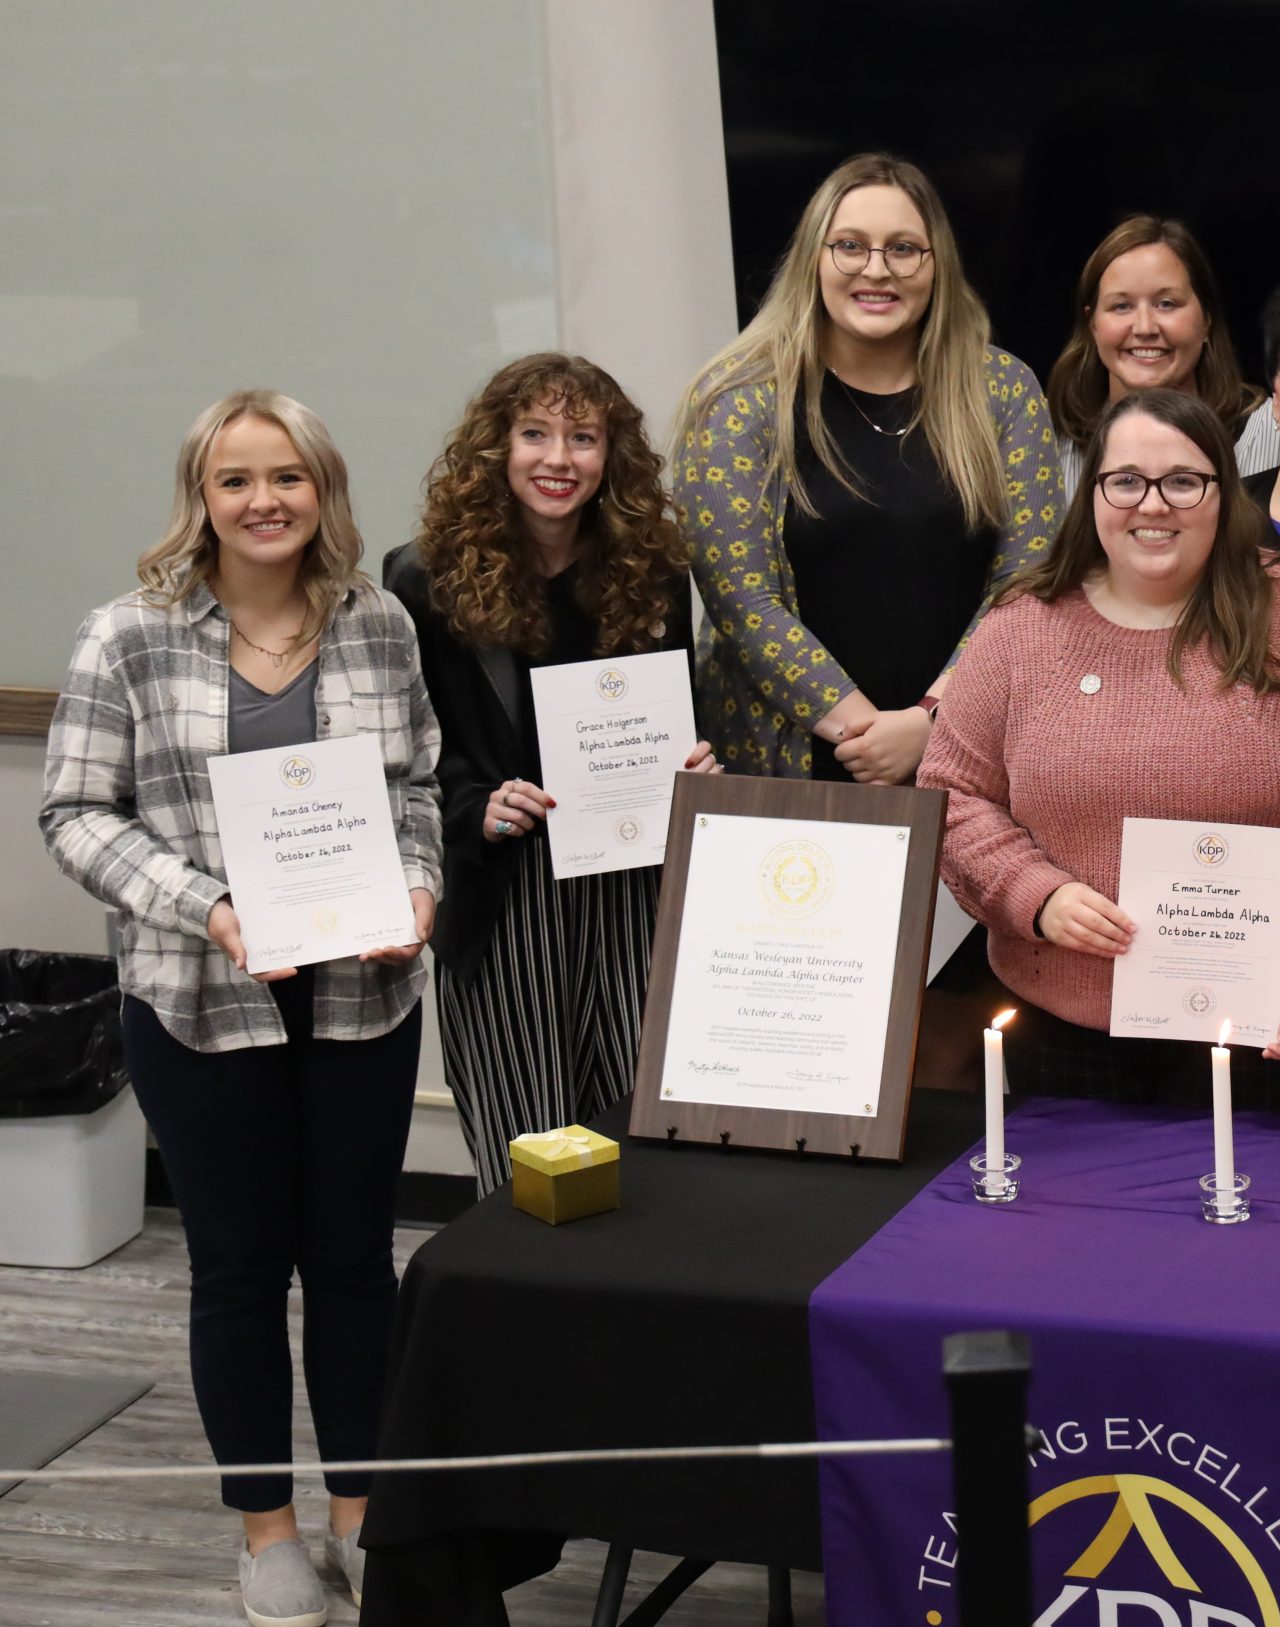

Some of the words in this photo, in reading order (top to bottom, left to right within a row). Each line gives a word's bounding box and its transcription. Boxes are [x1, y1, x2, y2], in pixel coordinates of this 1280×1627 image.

[602, 680, 622, 690] KDP
[576, 721, 603, 733] Grace
[580, 741, 605, 754] Alpha
[607, 735, 641, 748] Lambda
[645, 733, 669, 745] Alpha
[589, 761, 624, 772] October
[640, 756, 659, 765] 2022
[286, 768, 309, 778] KDP
[272, 807, 309, 818] Amanda
[312, 801, 342, 812] Cheney
[264, 829, 292, 842] Alpha
[295, 823, 332, 837] Lambda
[338, 817, 366, 830] Alpha
[276, 851, 315, 862] October
[319, 847, 331, 857] 26,
[333, 844, 352, 854] 2022
[1199, 846, 1223, 855] KDP
[1172, 883, 1202, 893] Emma
[1205, 885, 1240, 896] Turner
[1157, 904, 1189, 918] Alpha
[1192, 905, 1234, 919] Lambda
[1240, 908, 1269, 924] Alpha
[1159, 926, 1206, 938] October
[1225, 932, 1245, 941] 2022
[710, 949, 749, 960] Kansas
[754, 950, 802, 965] Wesleyan
[807, 956, 864, 970] University
[706, 964, 738, 976] Alpha
[742, 966, 783, 978] Lambda
[787, 970, 819, 982] Alpha
[822, 973, 864, 985] Chapter
[738, 1006, 778, 1018] October
[781, 1011, 795, 1020] 26,
[799, 1012, 823, 1021] 2022
